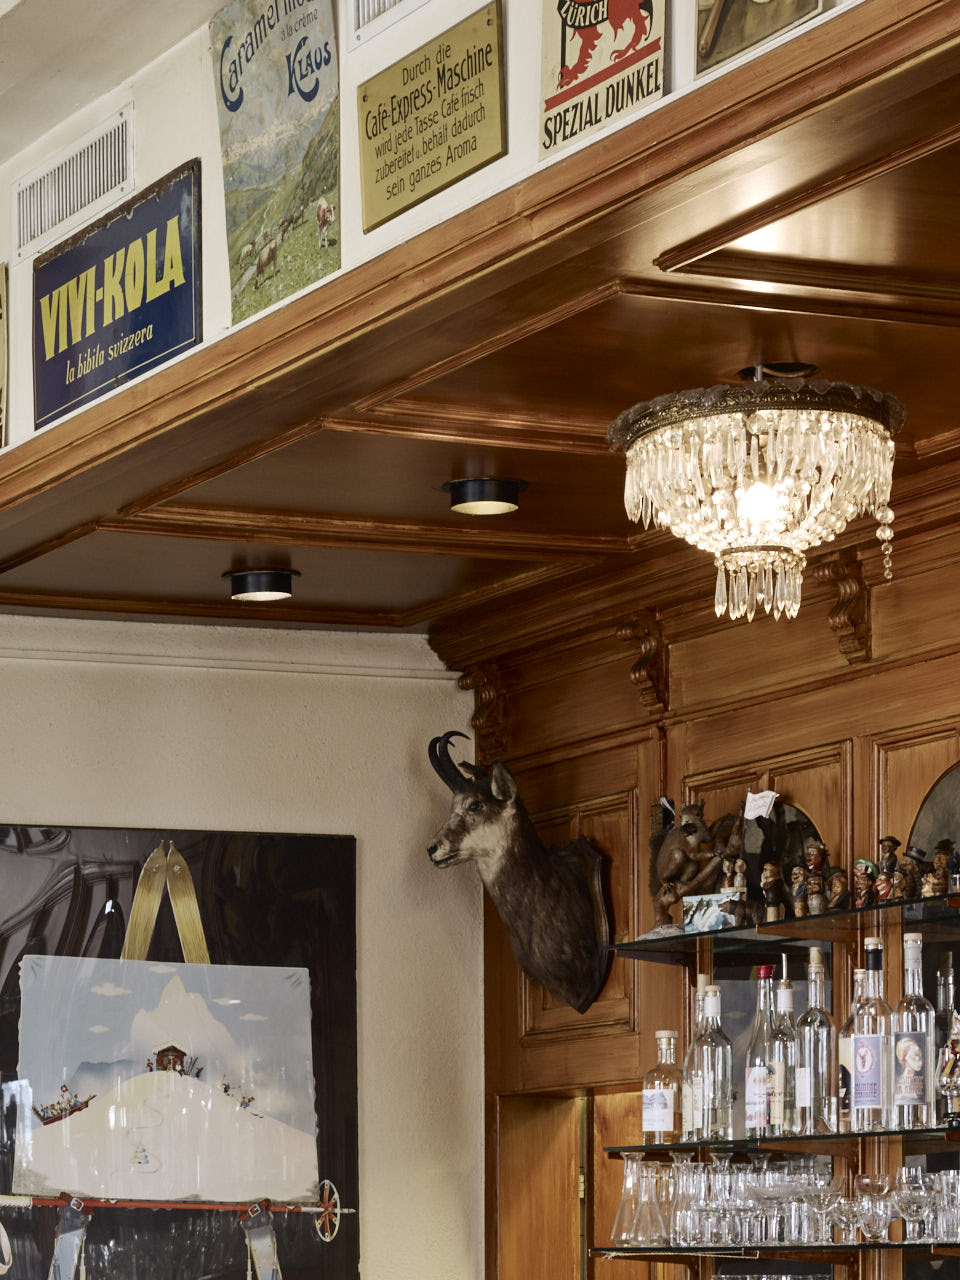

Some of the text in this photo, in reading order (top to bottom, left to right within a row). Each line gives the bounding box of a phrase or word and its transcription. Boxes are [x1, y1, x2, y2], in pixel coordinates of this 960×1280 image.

[561, 0, 608, 26] ZÜRICH
[221, 0, 280, 112] Caramel
[365, 43, 493, 140] Café-Express-Maschine
[402, 44, 451, 86] Durch die
[374, 78, 485, 159] wird jede Tasse Café frisch
[375, 146, 415, 183] zubereitet
[422, 123, 448, 155] behält
[452, 102, 486, 137] dadurch
[543, 57, 661, 150] SPEZIAL DUNKEL
[386, 135, 477, 200] sein ganzes Aroma
[40, 215, 186, 361] VIVI-KOLA
[65, 324, 153, 385] la bibita svizzera
